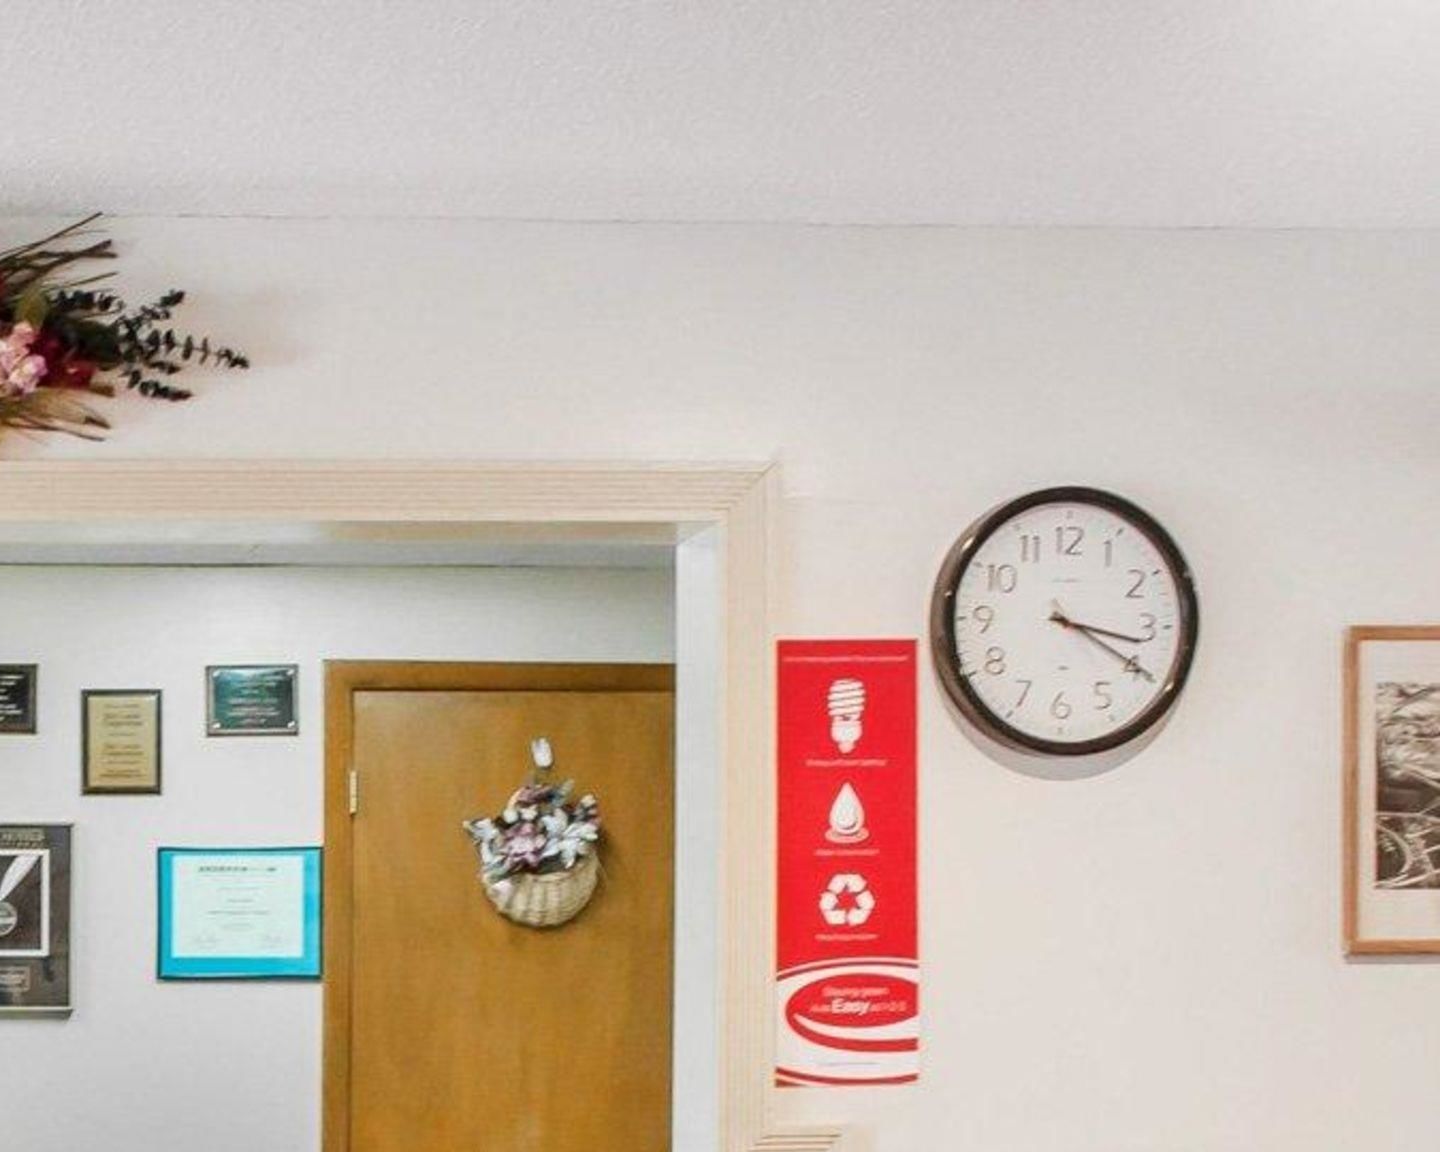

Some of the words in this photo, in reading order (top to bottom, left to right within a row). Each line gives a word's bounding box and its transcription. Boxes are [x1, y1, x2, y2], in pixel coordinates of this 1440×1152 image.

[1020, 535, 1040, 563] 11
[1056, 527, 1084, 555] 12
[1105, 540, 1113, 566] 1
[987, 564, 1017, 593] 10
[1126, 570, 1146, 598] 2
[973, 606, 994, 634] 9
[1140, 613, 1157, 642] 3
[986, 648, 1006, 675] 8
[1016, 681, 1032, 708] 7
[1051, 692, 1071, 719] 6
[1096, 683, 1112, 710] 5
[831, 997, 872, 1016] Easy
